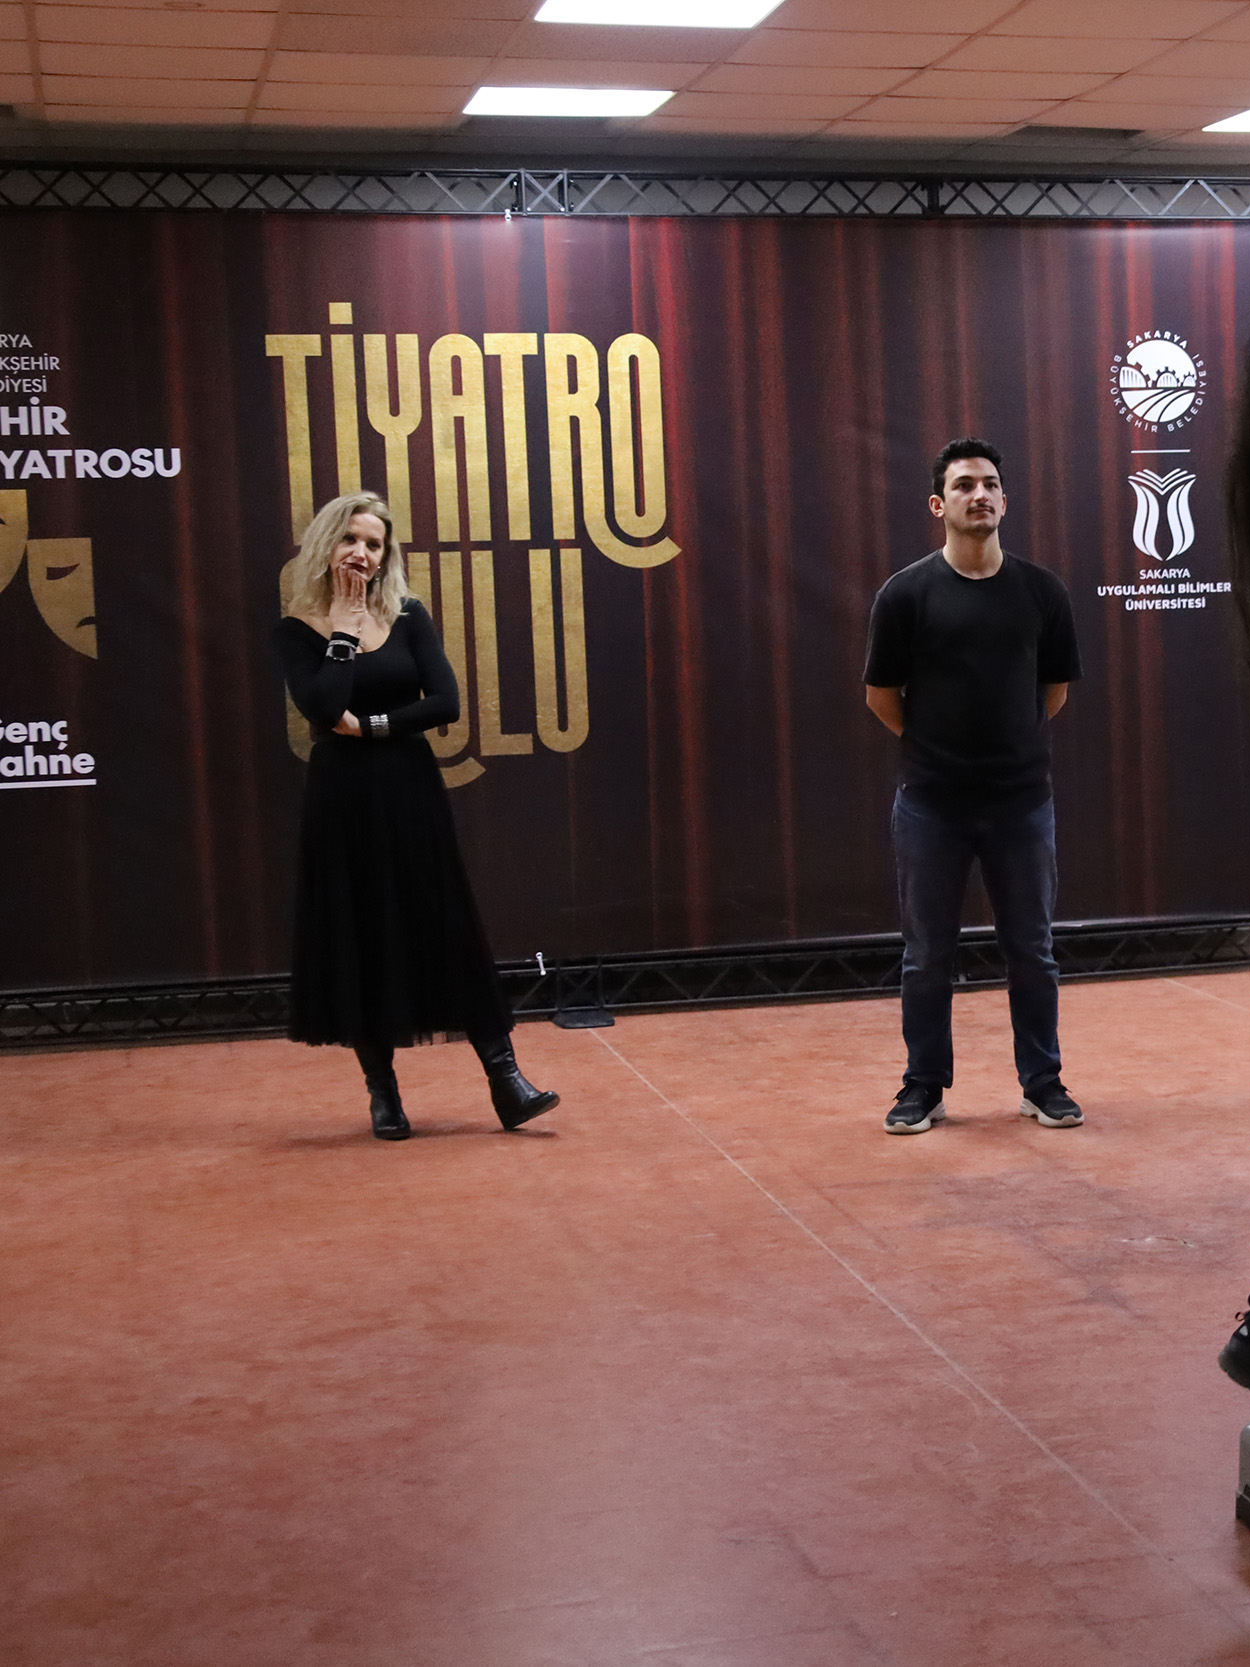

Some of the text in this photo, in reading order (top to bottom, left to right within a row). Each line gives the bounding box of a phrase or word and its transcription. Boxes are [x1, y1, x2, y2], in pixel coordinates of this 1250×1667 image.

[1126, 330, 1188, 349] SAKARYA
[0, 396, 71, 436] HİR
[265, 302, 682, 568] TİYATRO
[0, 448, 181, 479] YATROSU
[1139, 568, 1191, 580] SAKARYA
[1097, 582, 1232, 596] UYGULAMALI BİLİMLER
[1125, 596, 1206, 611] ÜNİVERSİTESİ
[280, 548, 590, 789] ULU
